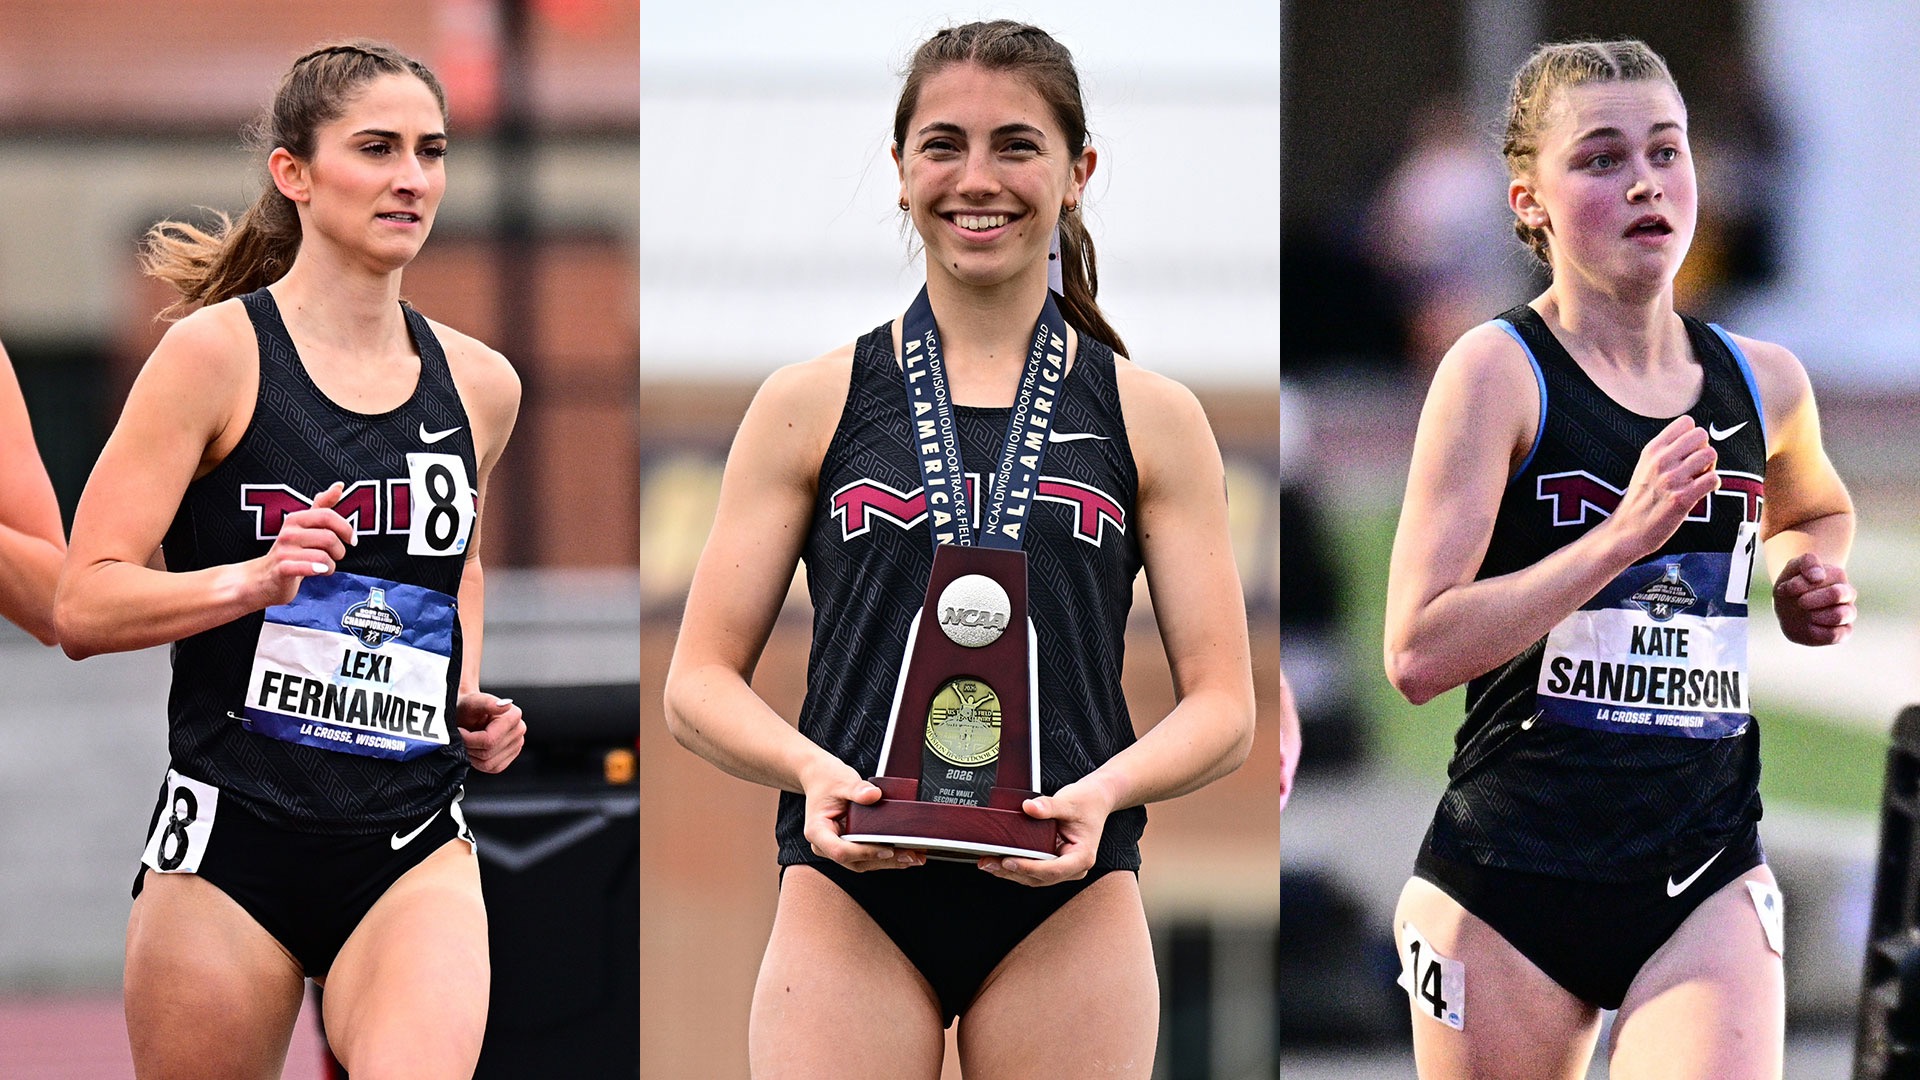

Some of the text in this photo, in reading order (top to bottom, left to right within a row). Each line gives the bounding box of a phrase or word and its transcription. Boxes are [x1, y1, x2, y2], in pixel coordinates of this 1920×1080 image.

[905, 340, 955, 545] ALL-AMERICAN
[924, 329, 971, 546] NCAA DIVISION III OUTDOOR TRACK & FIELD
[986, 323, 1049, 534] NCAA DIVISION III OUTDOOR TRACK & FIELD
[1002, 332, 1065, 540] ALL-AMERICAN
[241, 478, 478, 541] MI
[425, 463, 460, 552] 8
[831, 472, 1126, 548] MT
[343, 615, 401, 635] CHAMPIONSHIPS
[941, 606, 1006, 632] NCAA
[1631, 592, 1695, 606] CHAMPIONSHIPS
[340, 649, 392, 683] LEXI
[1631, 625, 1689, 658] KATE
[258, 670, 439, 739] FERNANDEZ
[1547, 656, 1741, 709] SANDERSON
[300, 723, 406, 752] LA CROSSE, WISCONSIN
[1596, 708, 1704, 728] LA CROSSE, WISCONSIN
[933, 795, 979, 807] SECOND PLACE
[939, 788, 974, 798] POLE VAULT
[946, 768, 974, 781] 2026
[157, 785, 198, 871] 8
[1409, 939, 1447, 1019] 14
